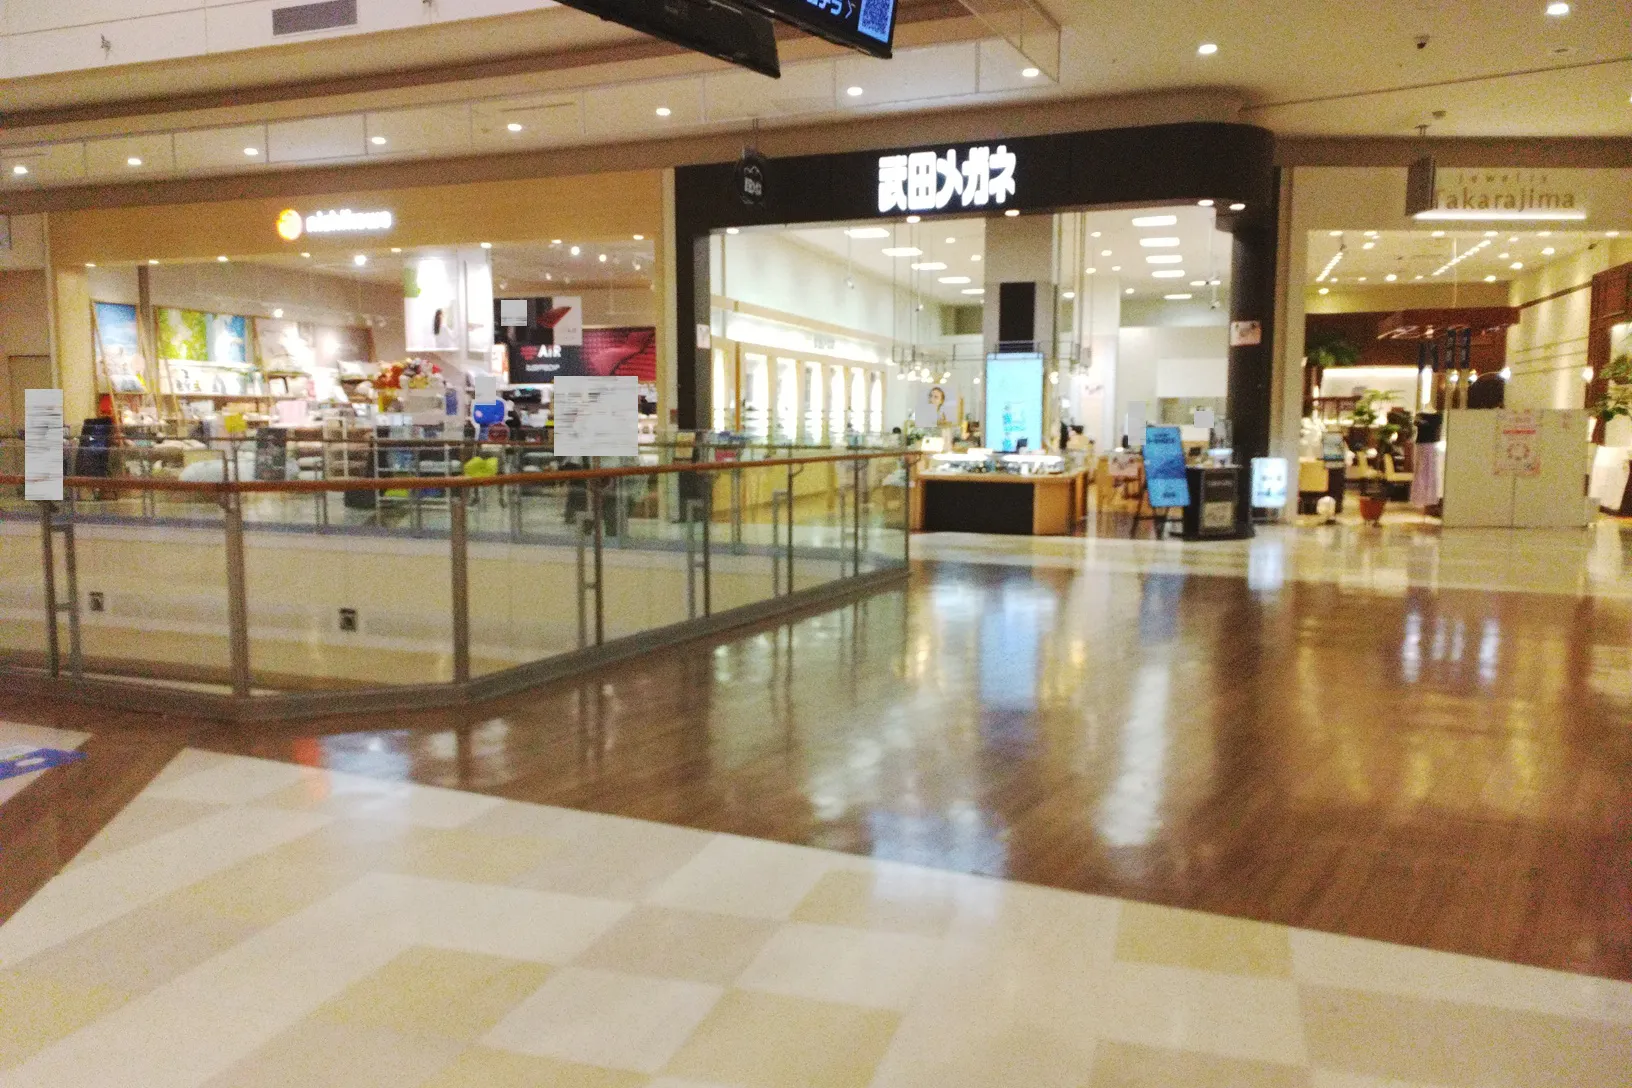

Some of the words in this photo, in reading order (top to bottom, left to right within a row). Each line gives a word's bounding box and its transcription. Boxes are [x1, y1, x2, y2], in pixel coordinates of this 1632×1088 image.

[878, 145, 1016, 212] 武田メガネ
